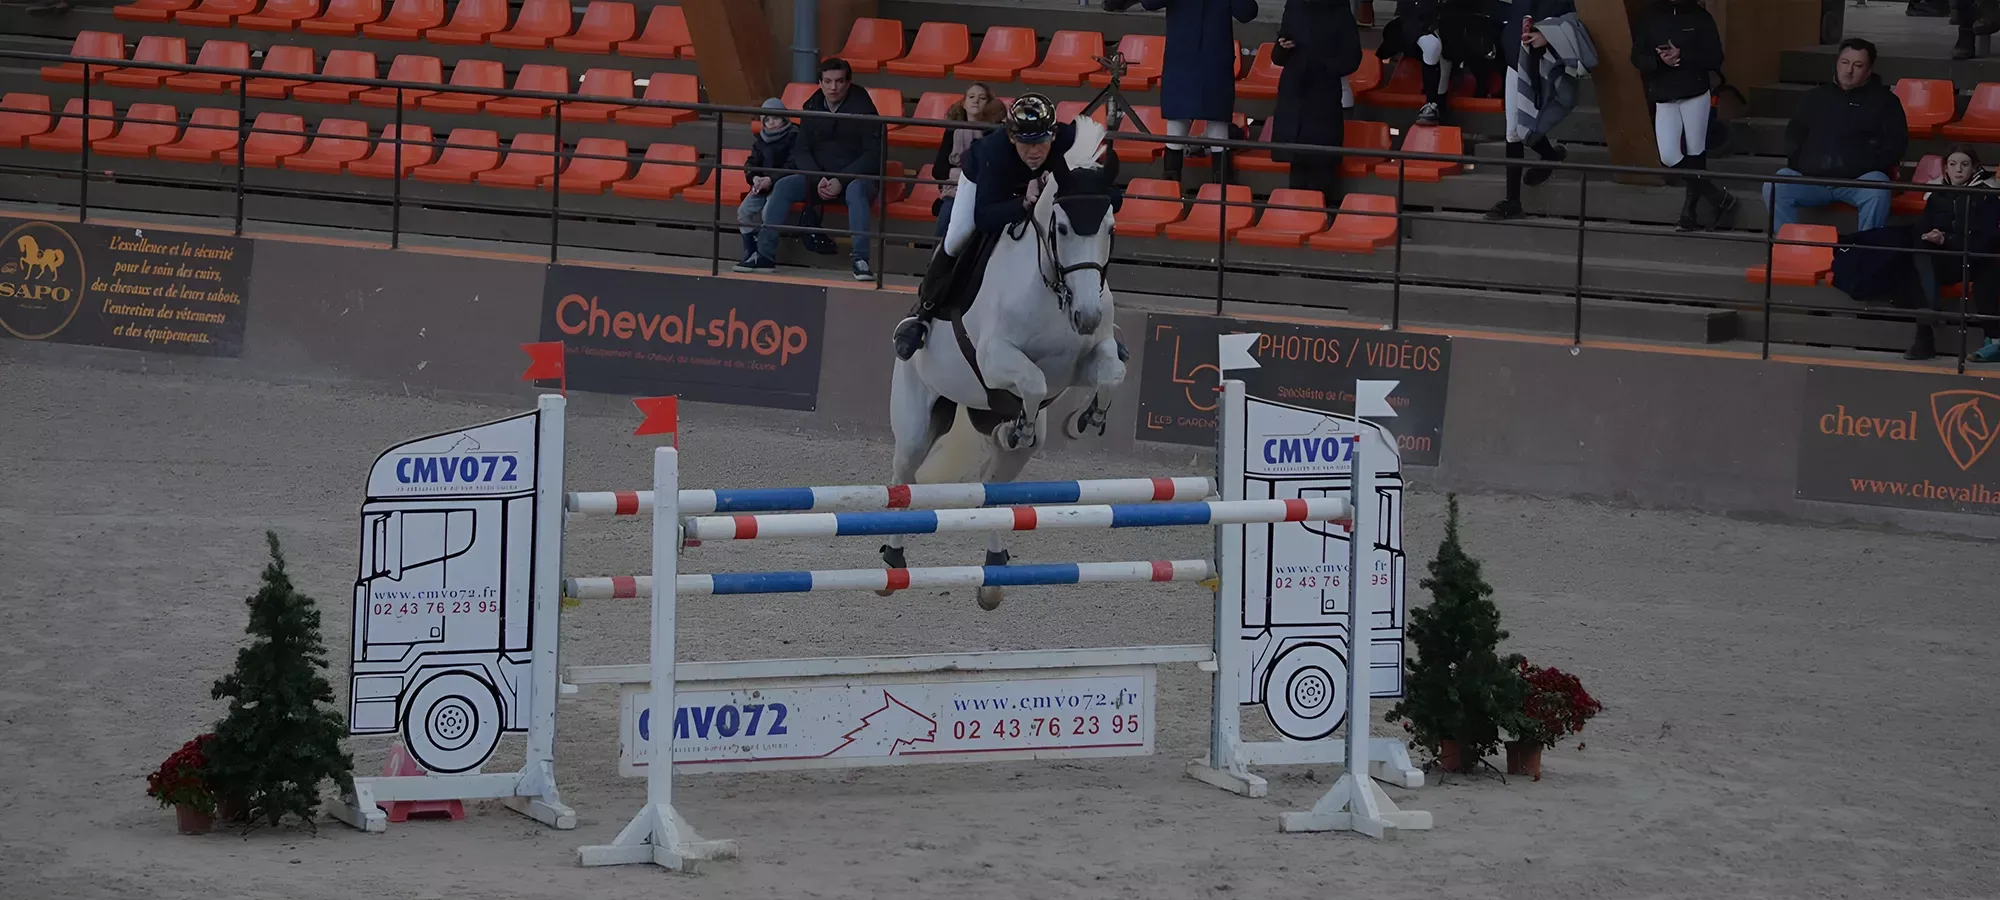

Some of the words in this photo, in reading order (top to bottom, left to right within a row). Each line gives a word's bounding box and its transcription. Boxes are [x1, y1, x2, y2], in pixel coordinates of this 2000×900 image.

[169, 245, 179, 256] et
[181, 241, 192, 257] la
[194, 244, 234, 260] sécurité
[112, 261, 139, 276] pour
[141, 260, 151, 274] le
[152, 262, 174, 276] soin
[176, 263, 192, 278] des
[195, 266, 222, 282] cuirs,
[0, 281, 71, 302] SAPO
[91, 277, 108, 291] des
[110, 278, 152, 296] chevaux
[153, 286, 163, 297] et
[165, 284, 178, 298] de
[179, 284, 205, 300] leurs
[103, 299, 155, 317] l'entretien
[157, 304, 174, 319] des
[176, 307, 226, 324] vêtements
[113, 325, 124, 336] et
[126, 322, 142, 337] des
[556, 293, 808, 366] Cheval-shop
[1258, 333, 1340, 363] PHOTOS
[1366, 340, 1441, 372] VIDÉOS
[1819, 404, 1917, 441] cheval
[1276, 577, 1292, 588] 02
[1299, 576, 1316, 588] 43
[1323, 575, 1340, 587] 76
[1372, 574, 1388, 585] 95
[374, 603, 392, 615] 02
[400, 602, 418, 615] 43
[427, 602, 445, 614] 76
[452, 601, 470, 614] 23
[478, 601, 497, 613] 95
[953, 720, 981, 740] 02
[993, 719, 1021, 738] 43
[1033, 717, 1061, 737] 76
[1073, 716, 1100, 735] 23
[1112, 714, 1138, 733] 95
